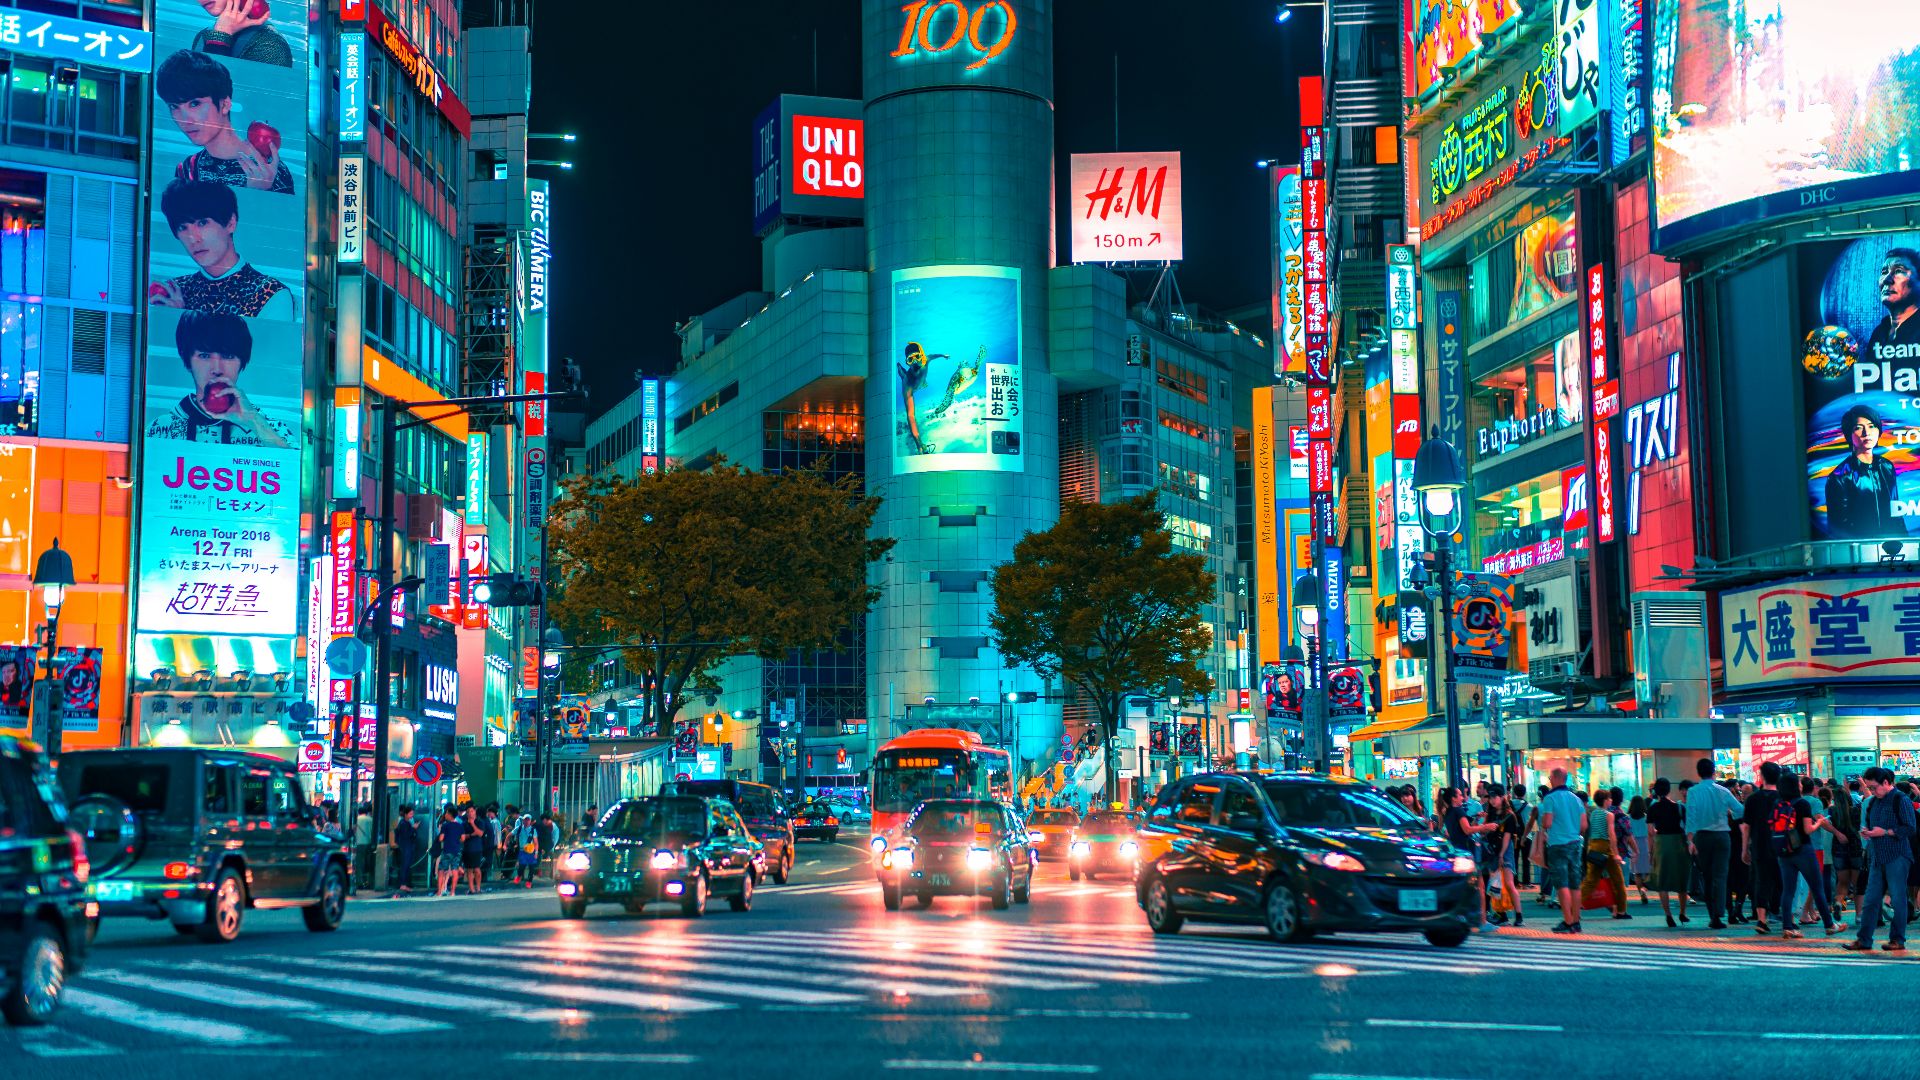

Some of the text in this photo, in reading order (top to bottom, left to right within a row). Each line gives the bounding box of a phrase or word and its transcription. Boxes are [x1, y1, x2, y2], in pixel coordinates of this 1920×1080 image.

[889, 0, 1018, 70] 109
[346, 44, 358, 130] 英会話イーオン
[416, 55, 443, 108] ガスト
[760, 118, 775, 169] THE
[803, 126, 856, 157] UNI
[755, 159, 779, 218] PRIME
[803, 158, 862, 190] QLO
[343, 163, 358, 255] 渋谷駅前ビル
[530, 190, 545, 223] BIC
[1085, 165, 1168, 221] H&M
[1800, 186, 1836, 206] DHC
[991, 374, 1019, 387] 世界に
[991, 386, 1019, 402] 出会
[1853, 361, 1920, 394] Pla
[991, 401, 1019, 417] おう
[1478, 404, 1554, 455] Euphoria
[163, 456, 281, 495] Jesus
[232, 458, 281, 468] NEW SINGLE
[1261, 472, 1272, 544] Matsumoto
[170, 526, 271, 542] Arena Tour 2018
[192, 540, 253, 558] 12.7 FRI
[158, 558, 279, 575] さいたまスーパーアリーナ
[435, 549, 446, 601] 渋谷駅前
[1401, 543, 1411, 576] フルーツ
[1328, 560, 1339, 610] MIZUHO
[1406, 606, 1427, 642] HUB
[1466, 657, 1477, 667] Tik
[426, 664, 458, 706] LUSH
